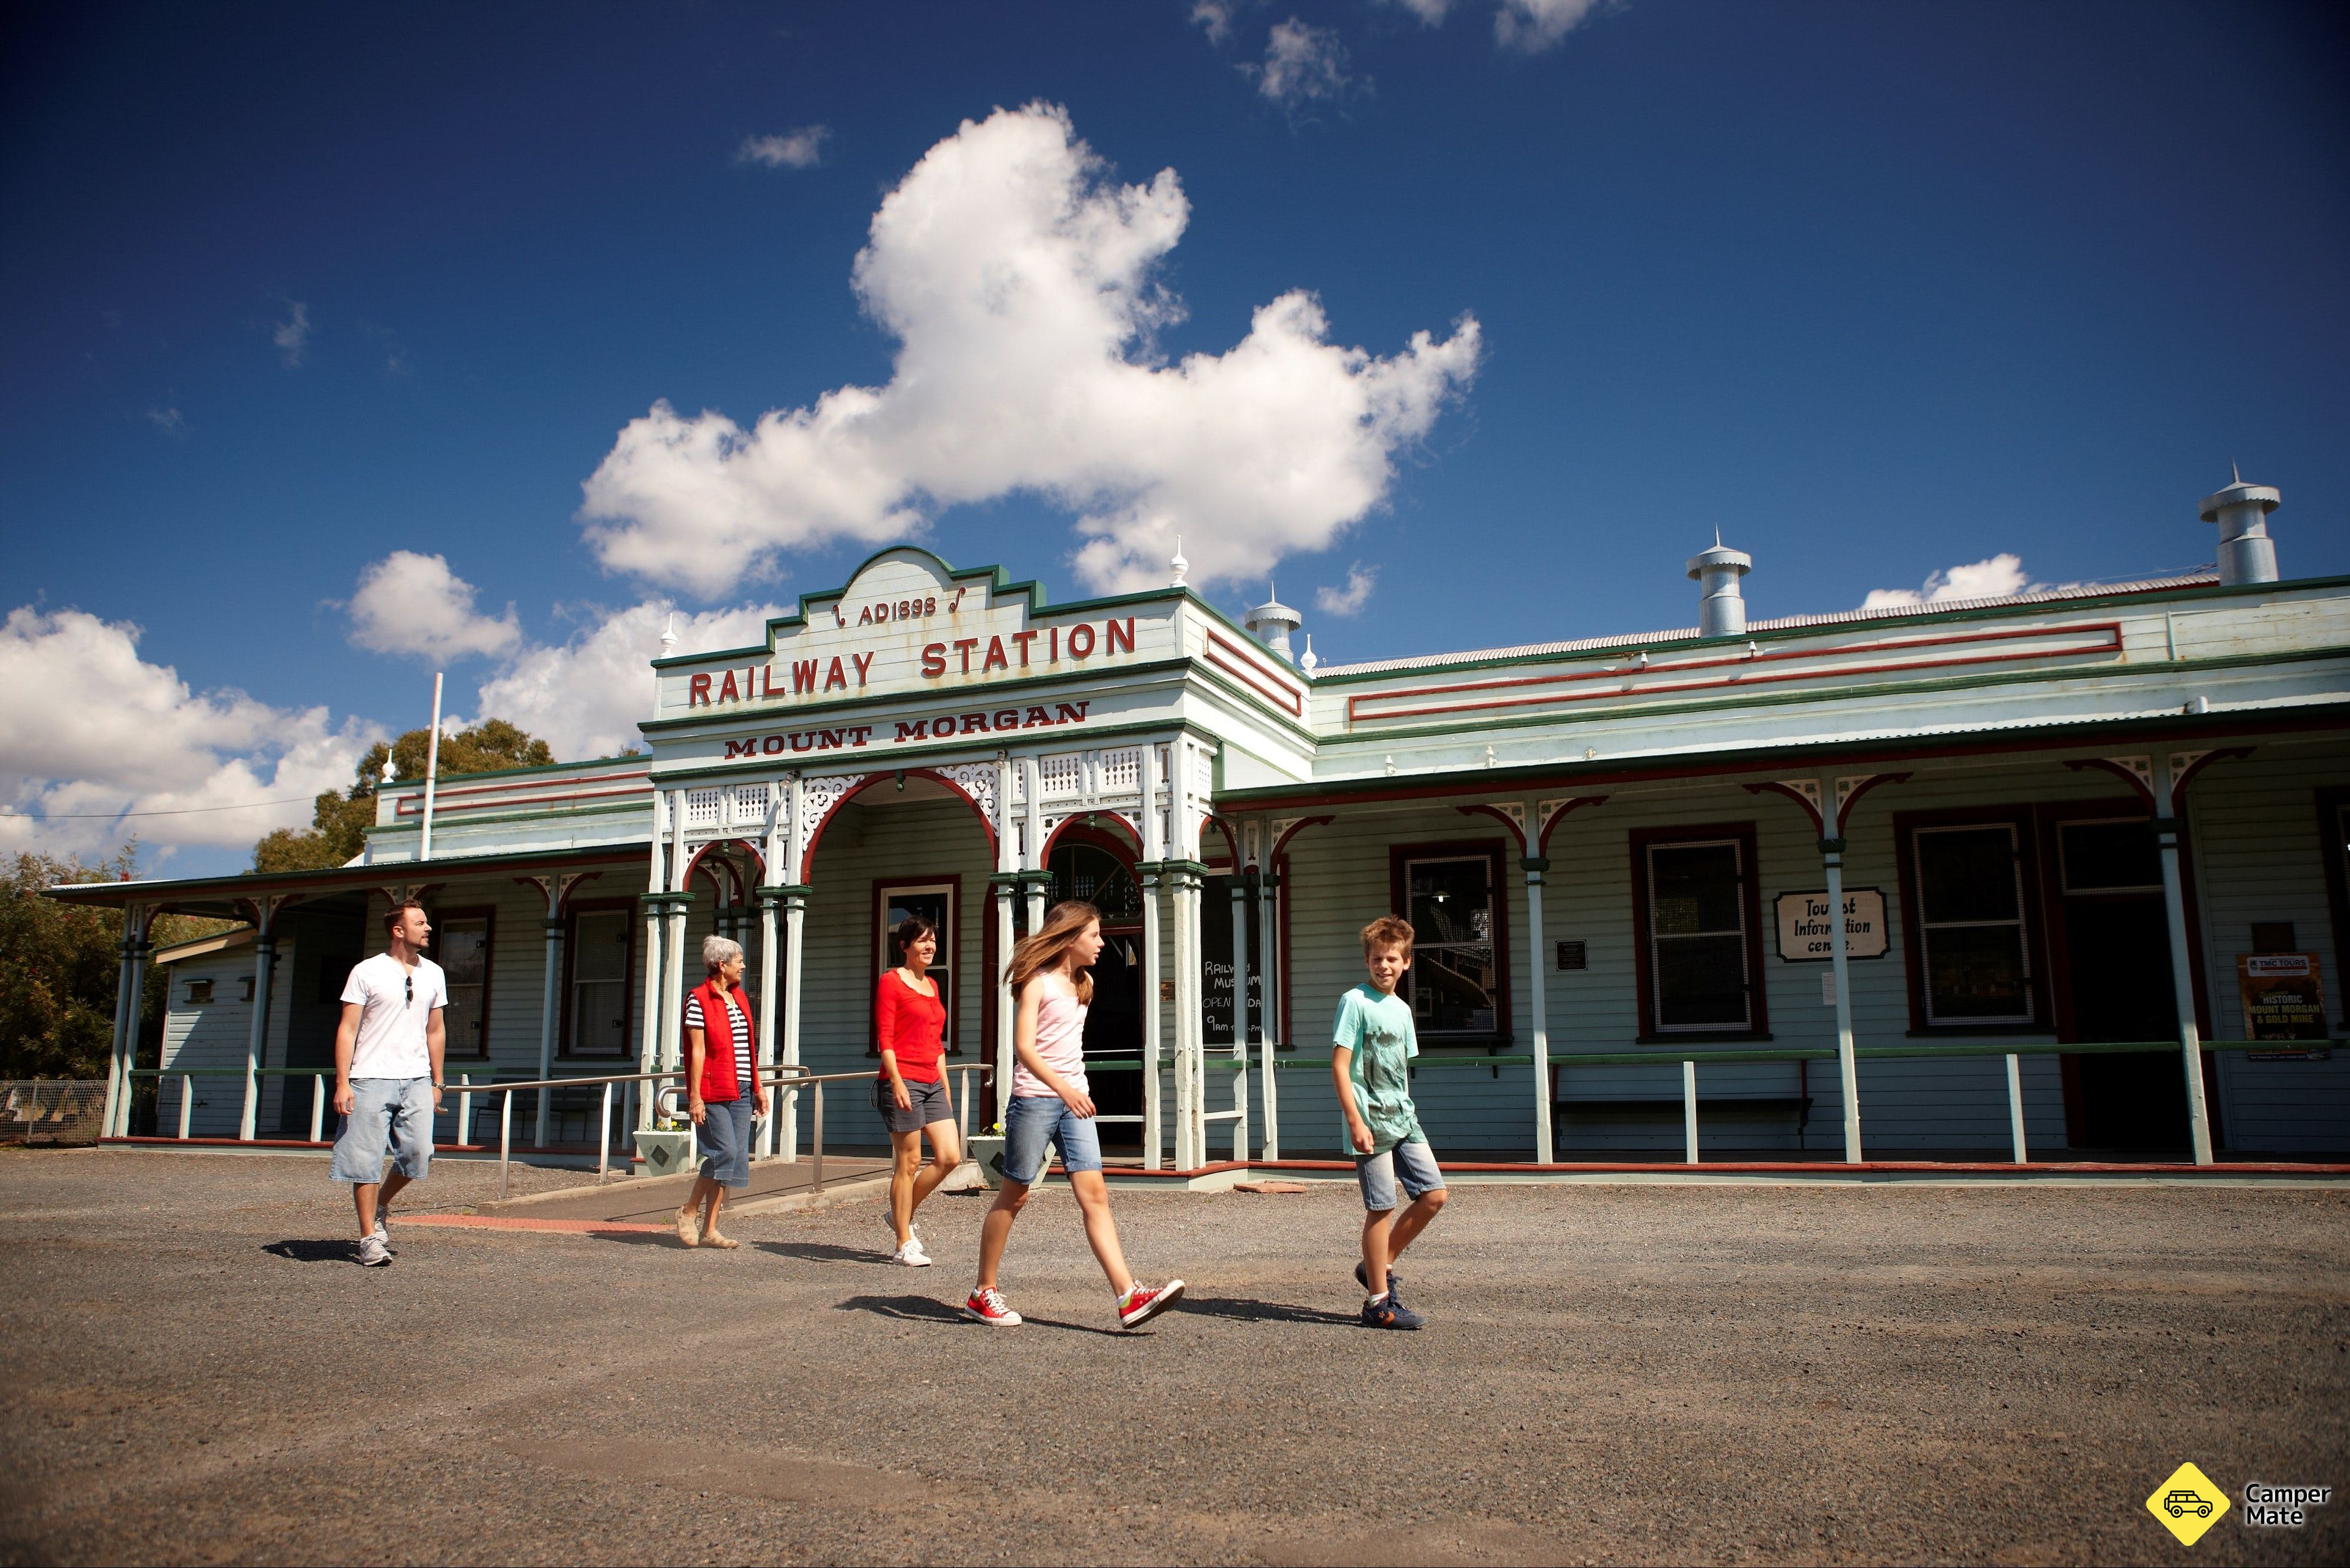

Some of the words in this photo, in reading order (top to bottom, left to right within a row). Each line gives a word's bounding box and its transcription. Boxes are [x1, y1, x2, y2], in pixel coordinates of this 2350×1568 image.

[690, 652, 874, 706] RAILWAY
[921, 616, 1135, 677] STATION
[724, 725, 872, 760] MOUNT
[894, 701, 1091, 743] MORGAN
[1806, 897, 1856, 916] Toust
[1202, 996, 1231, 1008] OPEN
[2263, 995, 2303, 1004] HISTORIC
[2249, 1005, 2279, 1014] MOUNT
[2282, 1004, 2321, 1013] MORGAN
[2256, 1015, 2264, 1024] &
[2265, 1015, 2289, 1024] GOLD
[2291, 1014, 2315, 1024] MINE
